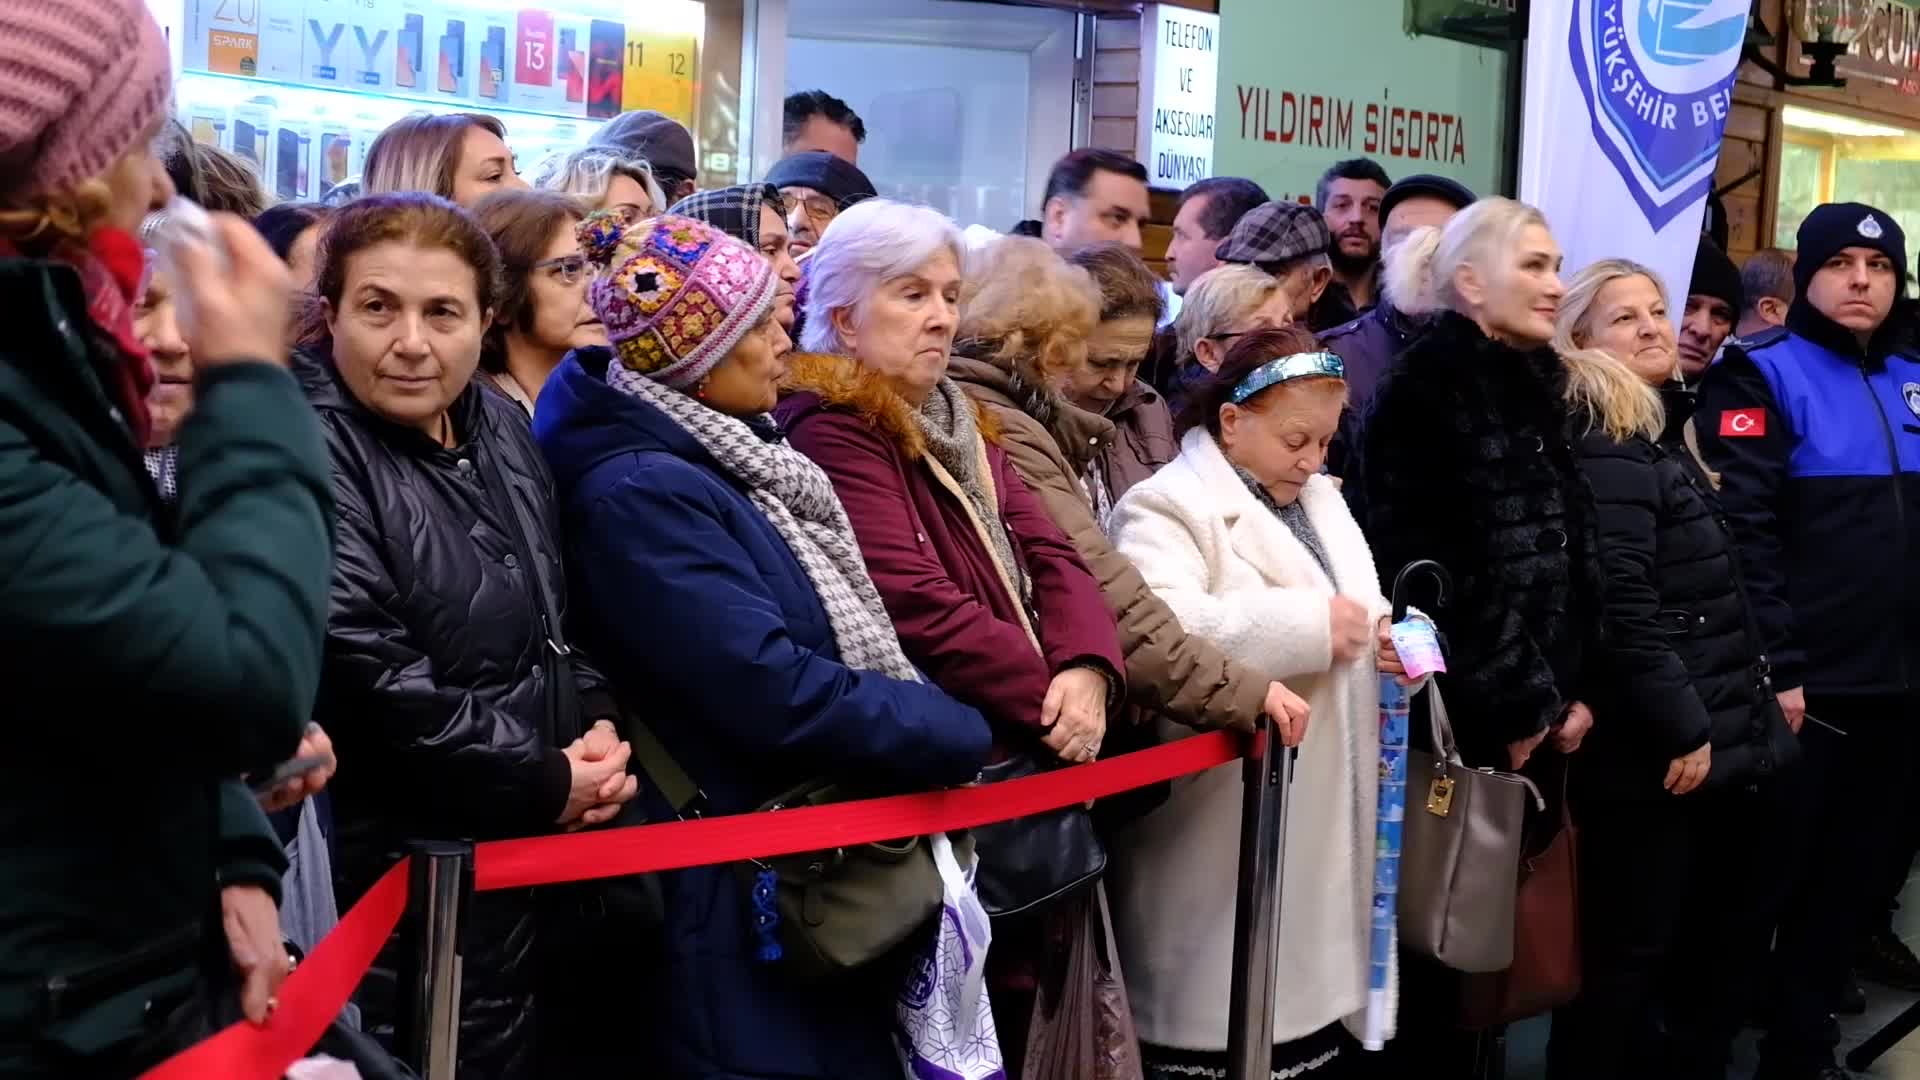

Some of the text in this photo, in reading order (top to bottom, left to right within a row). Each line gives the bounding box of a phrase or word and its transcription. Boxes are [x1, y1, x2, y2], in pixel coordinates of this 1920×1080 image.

[213, 34, 254, 49] SPARK
[1165, 19, 1213, 52] TELEFON
[524, 40, 545, 70] 13
[627, 40, 644, 68] 11
[668, 52, 686, 76] 12
[1603, 0, 1677, 130] YÜKŞEHİR
[1179, 67, 1194, 93] VE
[1154, 107, 1214, 140] AKSESUAR
[1237, 84, 1466, 165] YILDIRIM SİGORTA
[1158, 148, 1207, 183] DÜNYASI
